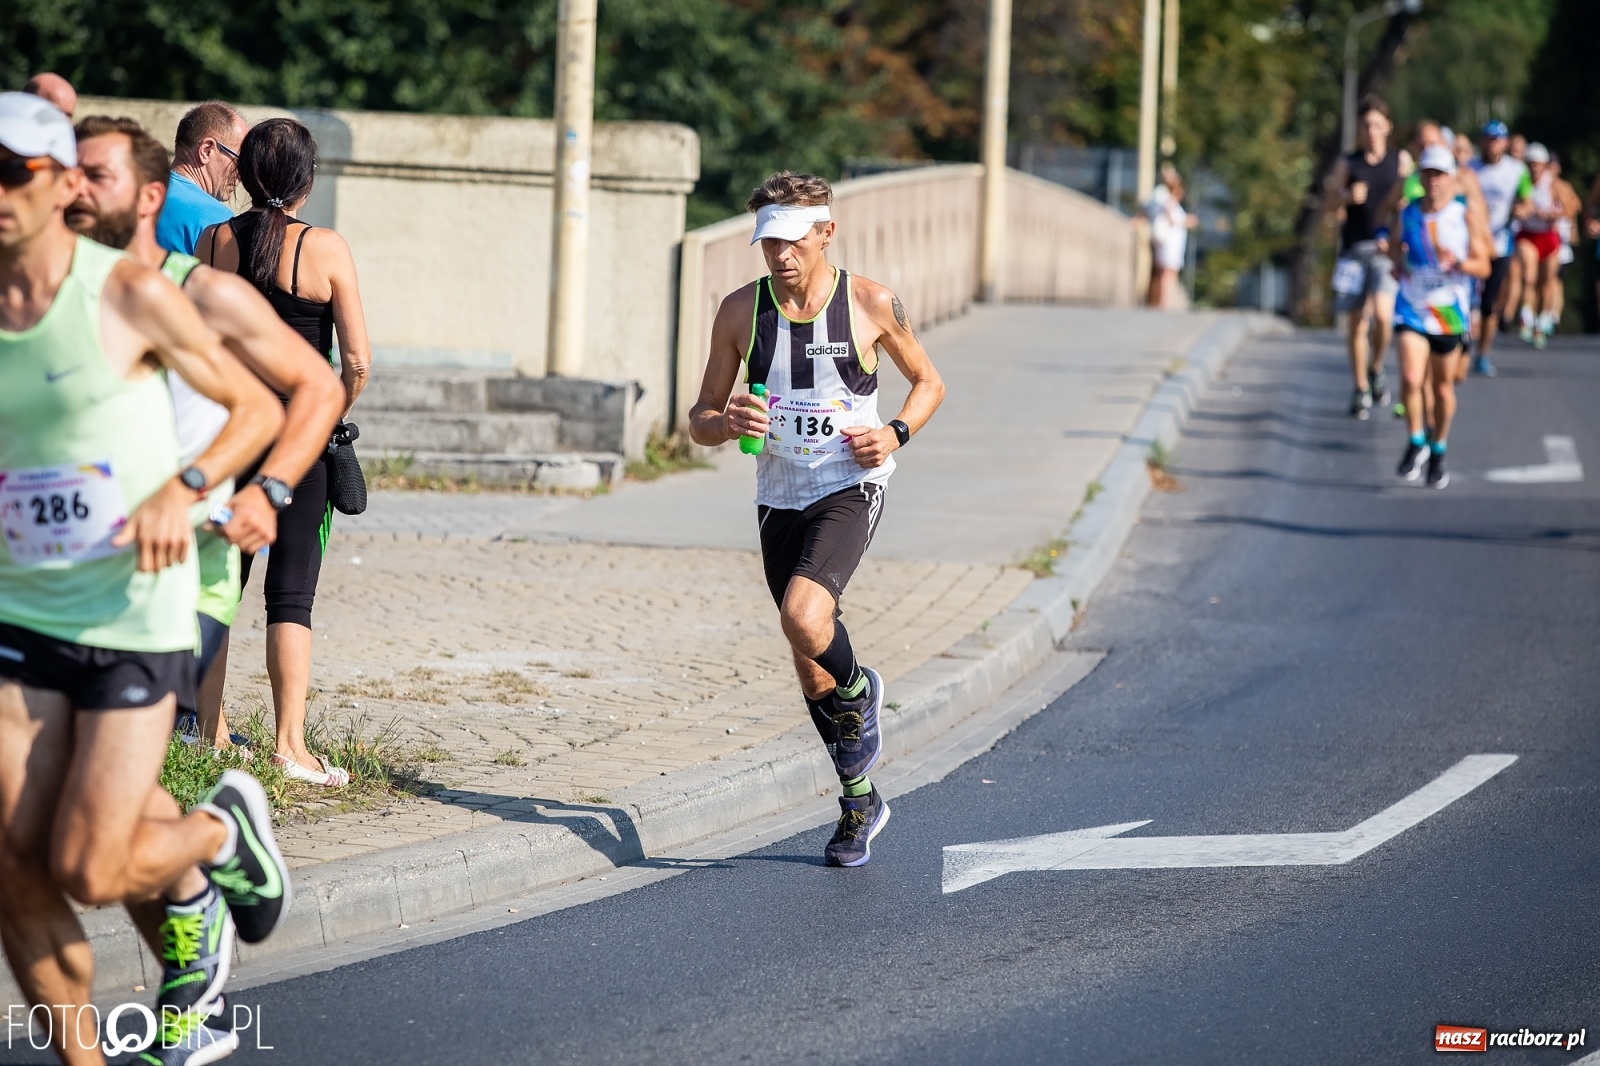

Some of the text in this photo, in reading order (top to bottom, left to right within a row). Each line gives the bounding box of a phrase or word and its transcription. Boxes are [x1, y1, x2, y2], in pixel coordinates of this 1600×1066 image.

[807, 345, 847, 355] adidas
[794, 415, 834, 436] 136
[31, 491, 89, 525] 286
